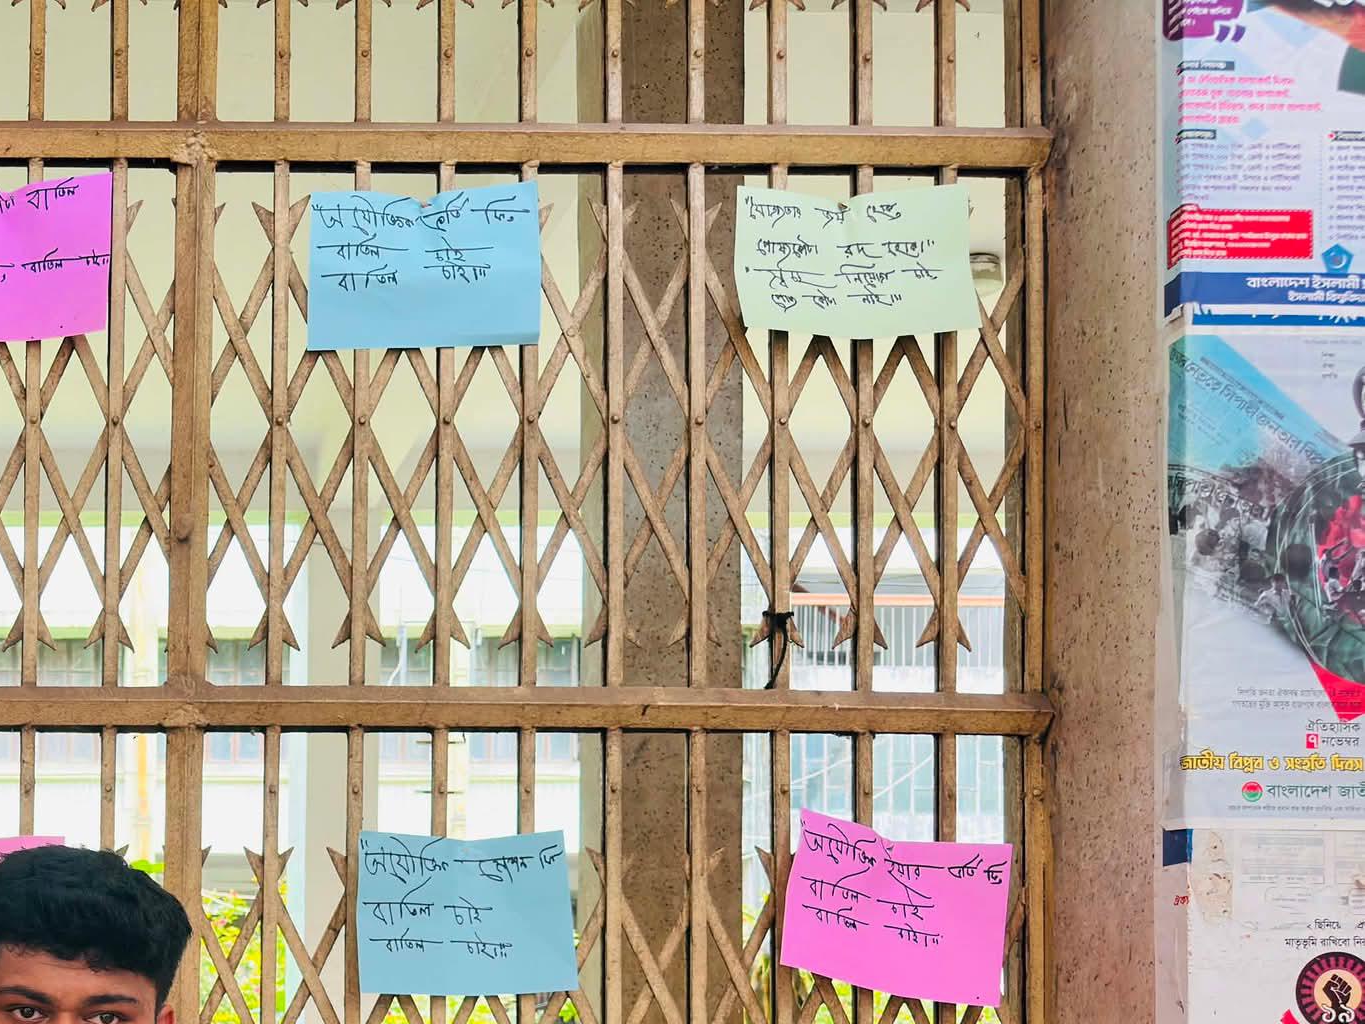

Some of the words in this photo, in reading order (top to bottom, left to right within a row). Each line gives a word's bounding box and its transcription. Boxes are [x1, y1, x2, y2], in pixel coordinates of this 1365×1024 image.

[26, 177, 79, 210] বাতিল
[316, 233, 409, 260] বাতিল
[425, 236, 494, 262] চাই
[321, 264, 398, 292] বাতিল
[1245, 275, 1310, 289] বাংলাদেশ
[1312, 275, 1361, 290] ইসলামী
[1306, 718, 1361, 733] ঐতিহাসিক
[1308, 734, 1318, 748] ৭
[1321, 736, 1360, 747] নভেম্বর
[1180, 749, 1226, 771] জাতীয়
[1228, 751, 1264, 773] বিপ্লব
[1268, 757, 1280, 771] ও
[1285, 752, 1326, 772] সংহতি
[1330, 753, 1364, 772] দিবস
[1266, 784, 1332, 799] বাংলাদেশ
[362, 877, 434, 925] বাতিল
[444, 896, 493, 925] চাই
[801, 867, 871, 903] বাতিল
[877, 888, 935, 920] চাই
[369, 928, 443, 953] বাতিল
[1321, 1004, 1355, 1024] ১৯
